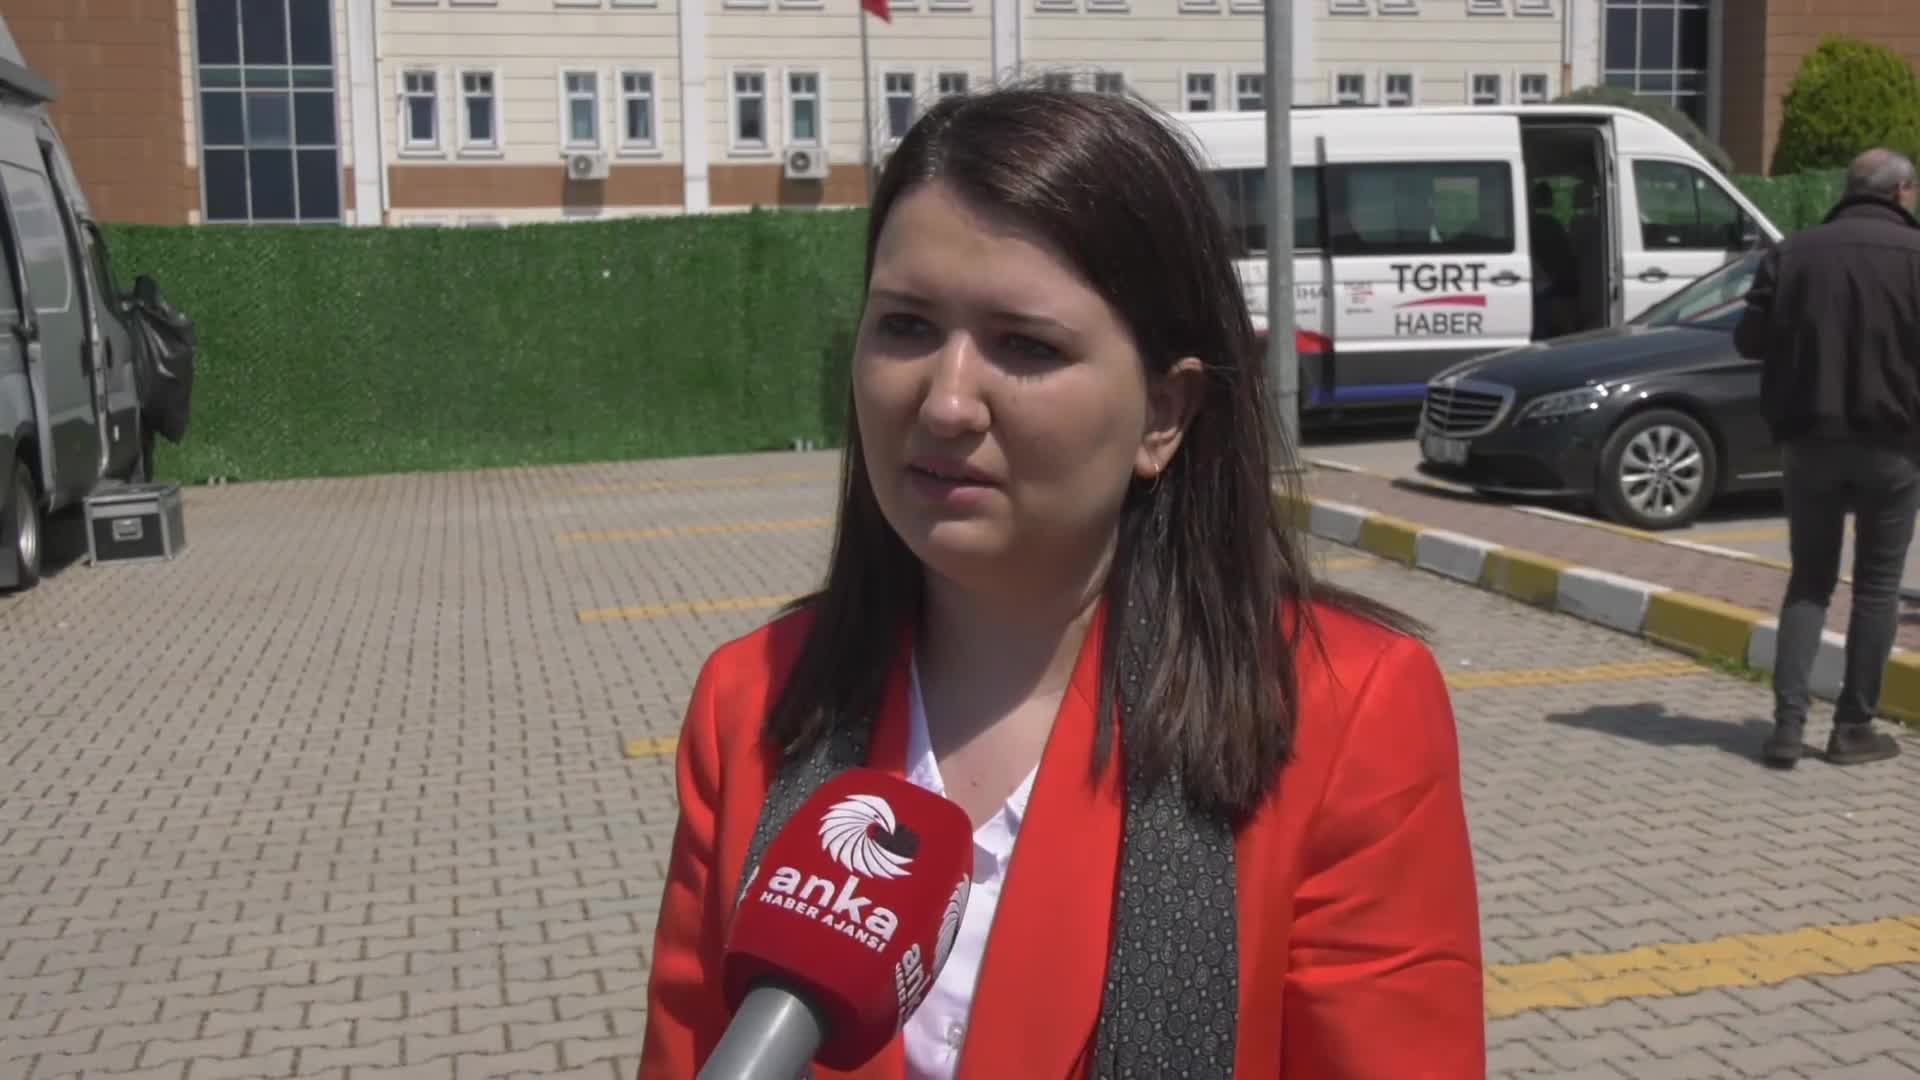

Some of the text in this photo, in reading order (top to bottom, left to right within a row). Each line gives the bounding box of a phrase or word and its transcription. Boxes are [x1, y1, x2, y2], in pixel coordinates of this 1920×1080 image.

[1390, 264, 1486, 292] TGRT
[1395, 313, 1483, 336] HABER
[760, 891, 886, 952] HABER AJANSI
[768, 866, 898, 942] anka
